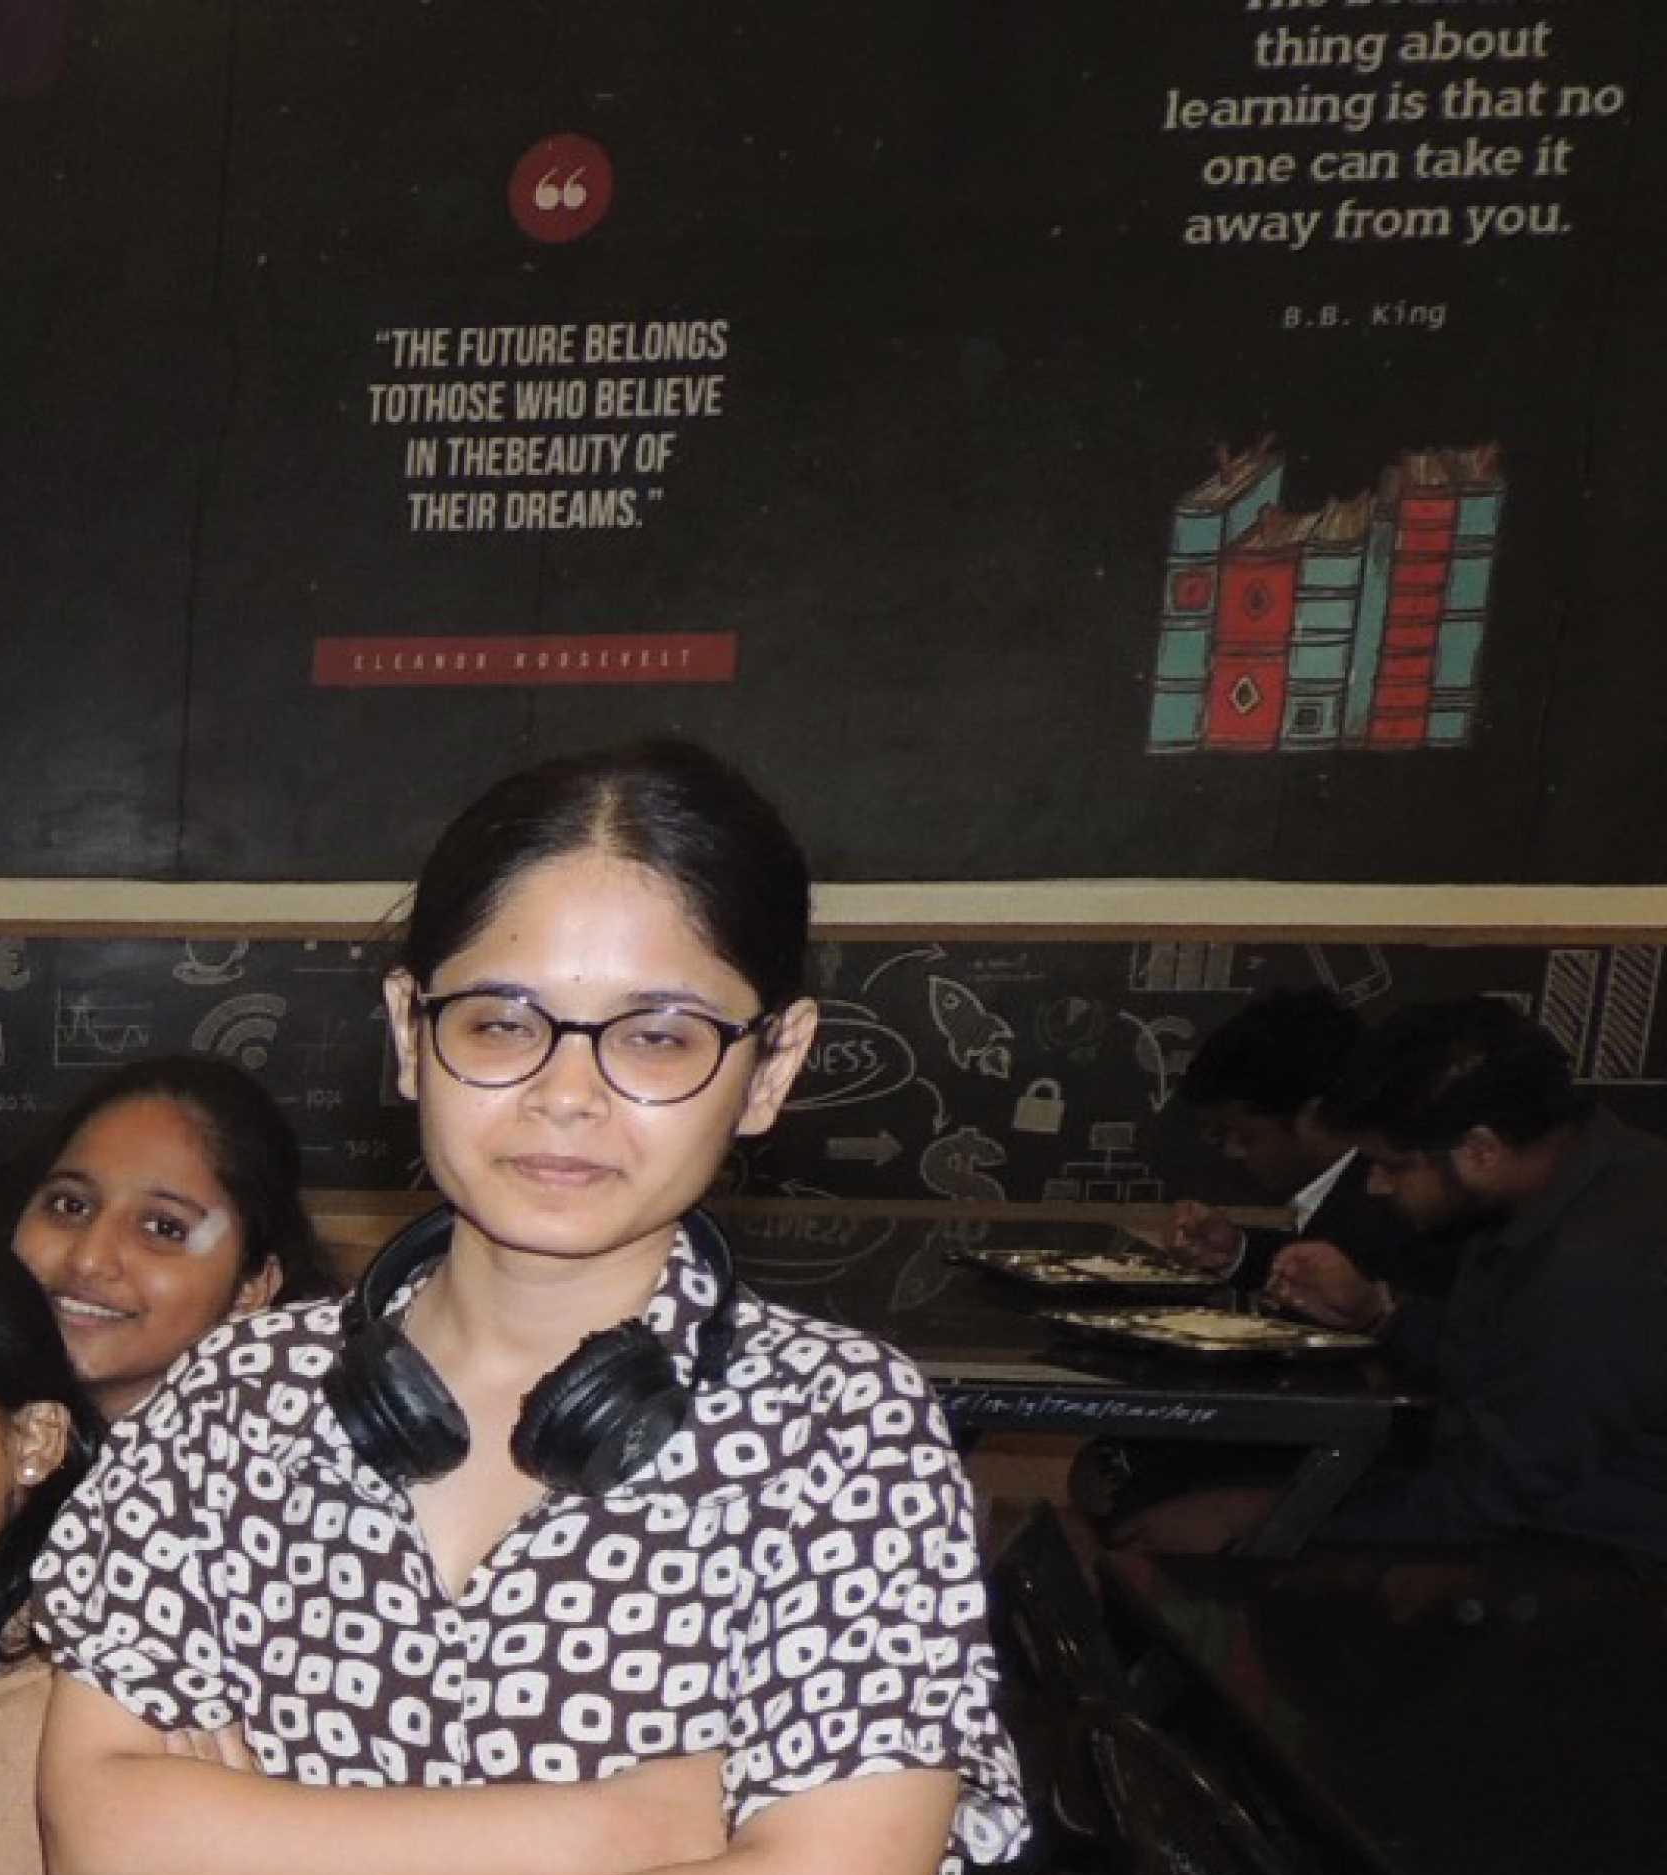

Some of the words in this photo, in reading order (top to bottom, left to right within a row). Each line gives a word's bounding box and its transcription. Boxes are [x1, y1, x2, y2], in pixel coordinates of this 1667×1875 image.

[1256, 24, 1388, 73] thing
[1398, 19, 1553, 63] about
[1163, 83, 1377, 132] learning
[1385, 80, 1427, 121] is
[1441, 77, 1547, 120] that
[1557, 84, 1624, 117] no
[1203, 152, 1296, 185] one
[1310, 149, 1399, 182] can
[1413, 136, 1522, 179] take
[1534, 136, 1574, 176] it
[1184, 211, 1322, 251] away
[1334, 199, 1450, 239] from
[1464, 202, 1571, 245] you.
[1282, 304, 1350, 329] B.B.
[1372, 299, 1447, 329] King
[457, 324, 577, 367] FUTURE
[584, 318, 729, 364] BELONGS
[369, 380, 506, 424] TOTHOSE
[515, 380, 587, 420] WHO
[594, 374, 724, 419] BELIEVE
[404, 437, 437, 479] IN
[446, 433, 628, 476] THEBEAUTY
[635, 431, 677, 473] OF
[407, 492, 496, 532] THEIR
